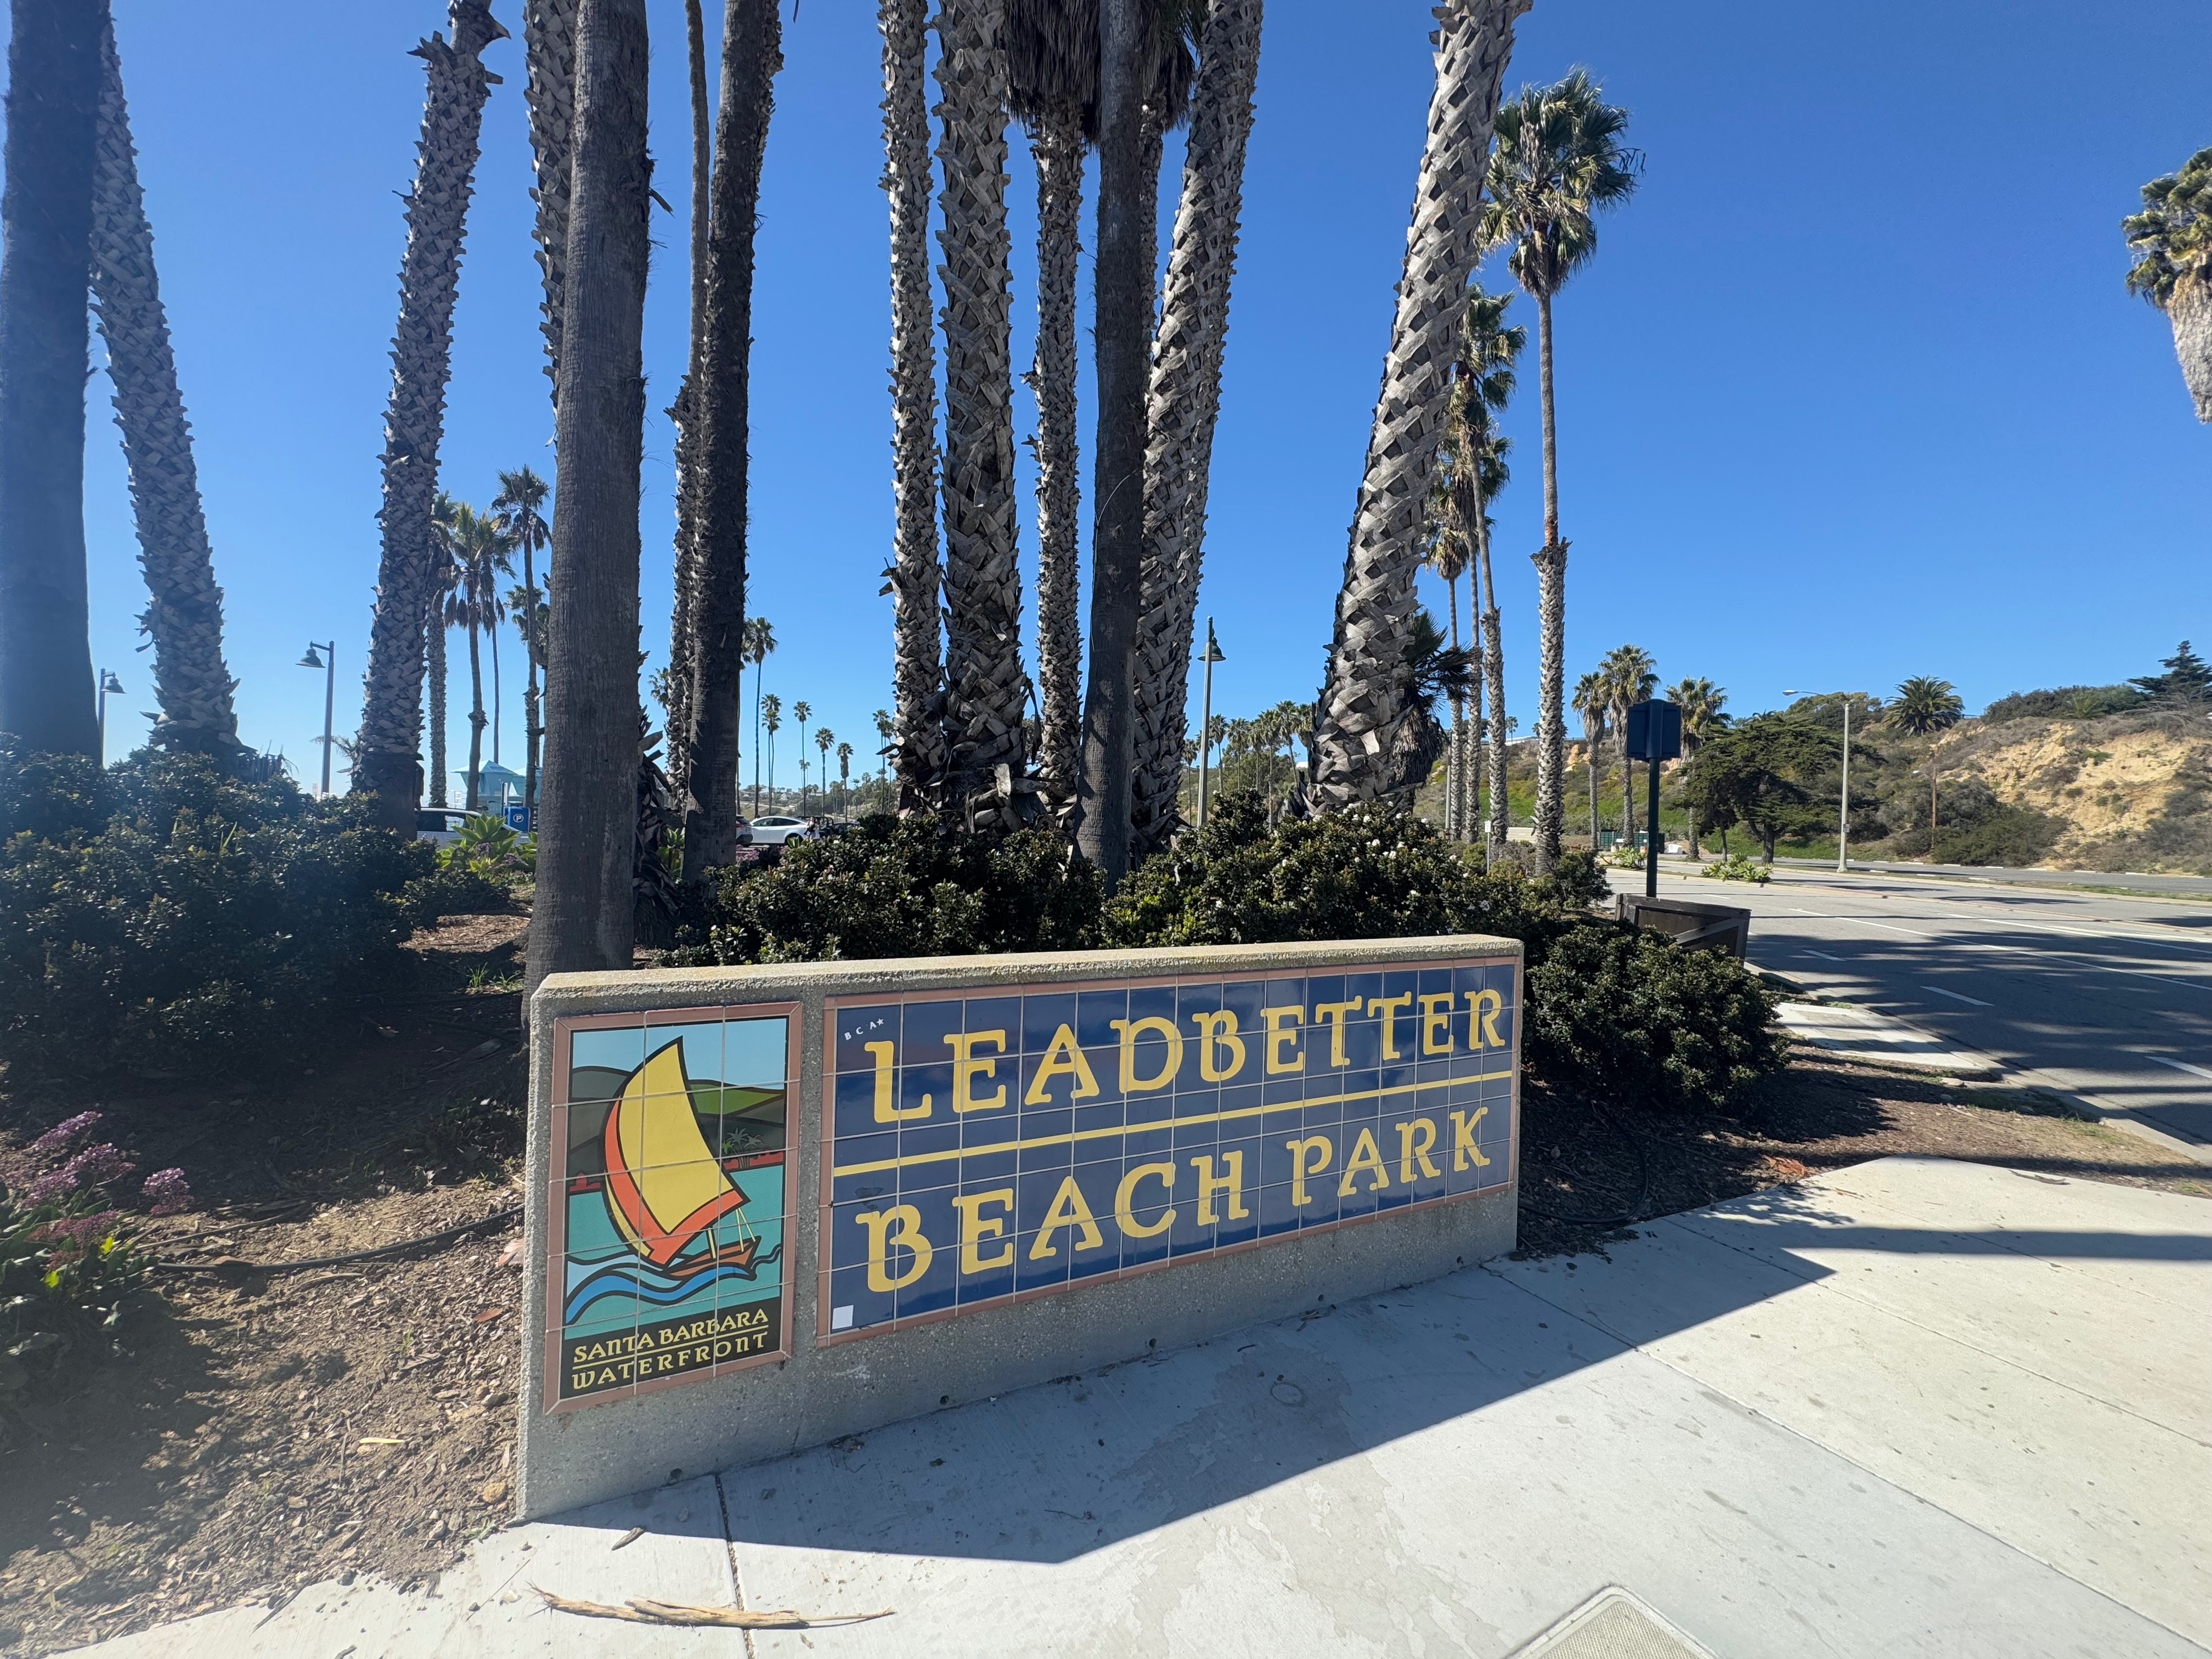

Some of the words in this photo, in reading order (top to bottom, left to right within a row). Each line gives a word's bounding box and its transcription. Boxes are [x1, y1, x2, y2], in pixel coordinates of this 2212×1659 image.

[864, 989, 1505, 1124] LEADBETTER
[856, 1150, 1249, 1293] BEACH
[1286, 1107, 1491, 1206] PARK
[572, 1331, 768, 1389] WATERFRONT
[573, 1333, 655, 1363] SANTA
[659, 1308, 769, 1345] BARBARA
